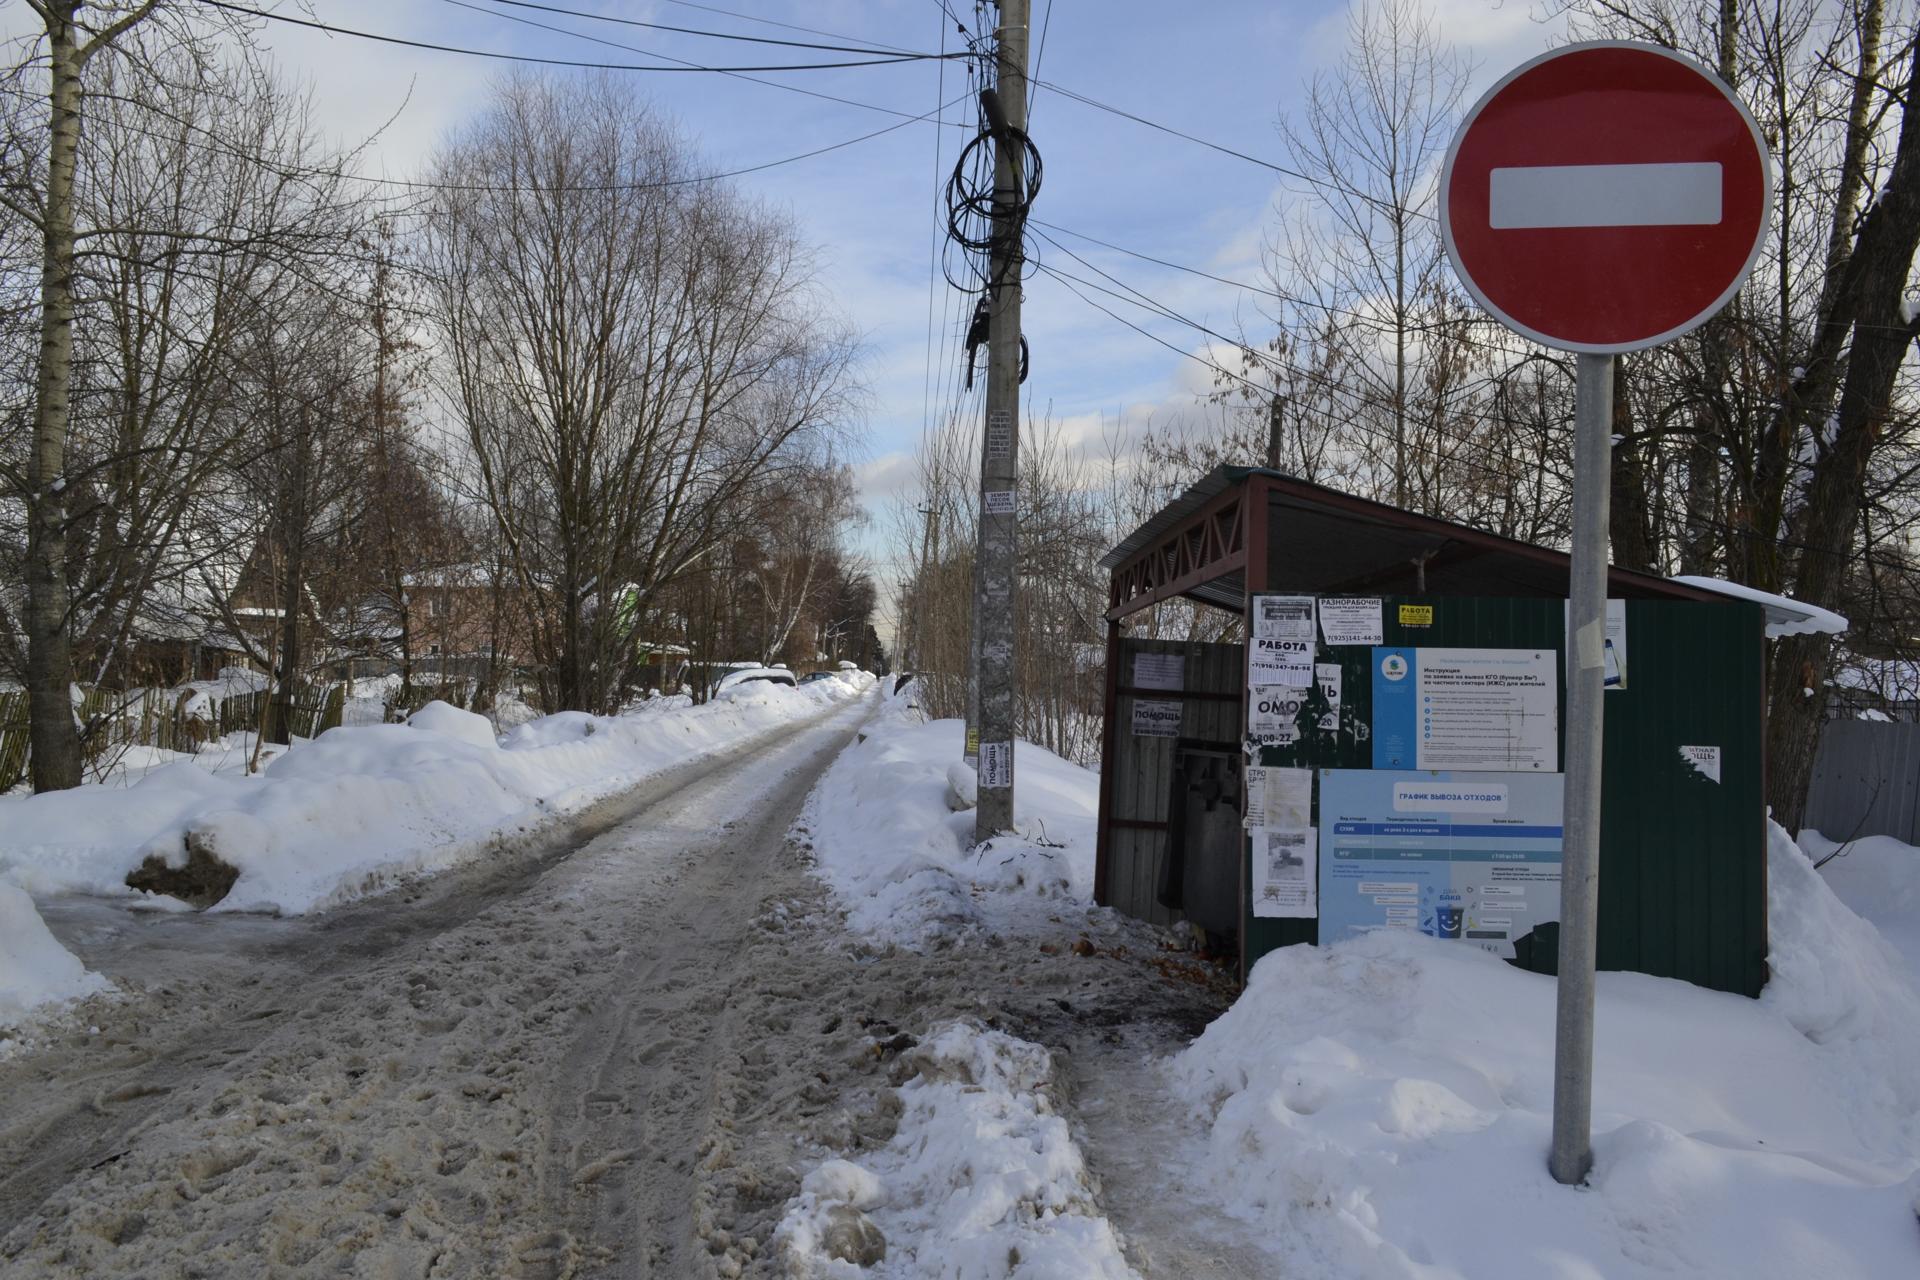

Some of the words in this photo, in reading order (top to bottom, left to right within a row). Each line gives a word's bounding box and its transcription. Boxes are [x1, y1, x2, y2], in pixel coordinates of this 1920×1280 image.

[1258, 640, 1307, 651] РАБОТА
[1135, 710, 1181, 721] ПОМОЩЬ
[988, 745, 997, 784] ПОМОЩЬ
[1399, 793, 1428, 802] ГРАФИК
[1430, 793, 1462, 802] ВЫВОЗА
[1463, 793, 1502, 802] ОТХОДОВ
